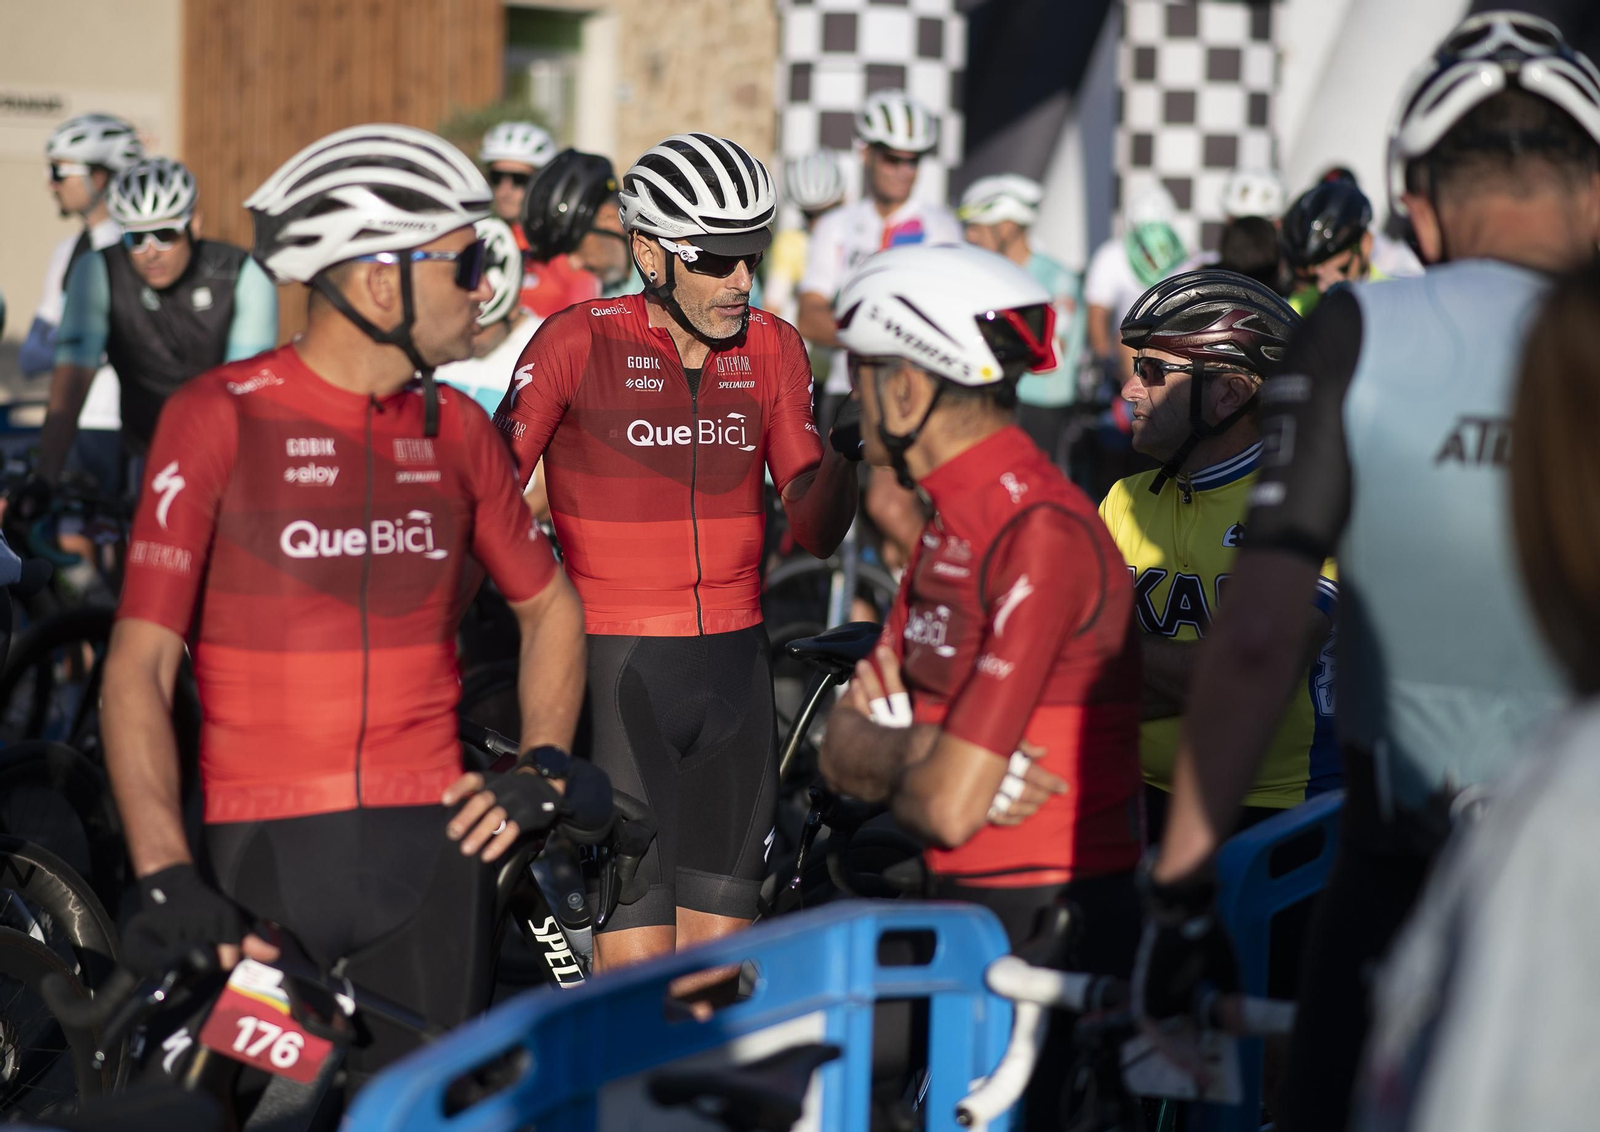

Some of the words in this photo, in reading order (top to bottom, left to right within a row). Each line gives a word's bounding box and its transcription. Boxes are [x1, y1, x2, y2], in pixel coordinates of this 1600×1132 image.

[748, 313, 767, 325] Bici
[627, 356, 661, 370] GOBIK
[635, 375, 665, 392] eloy
[718, 380, 756, 389] SPECIALIZED
[286, 438, 337, 457] GOBIK
[297, 462, 340, 487] eloy
[1129, 565, 1234, 640] KA
[232, 1015, 305, 1069] 176
